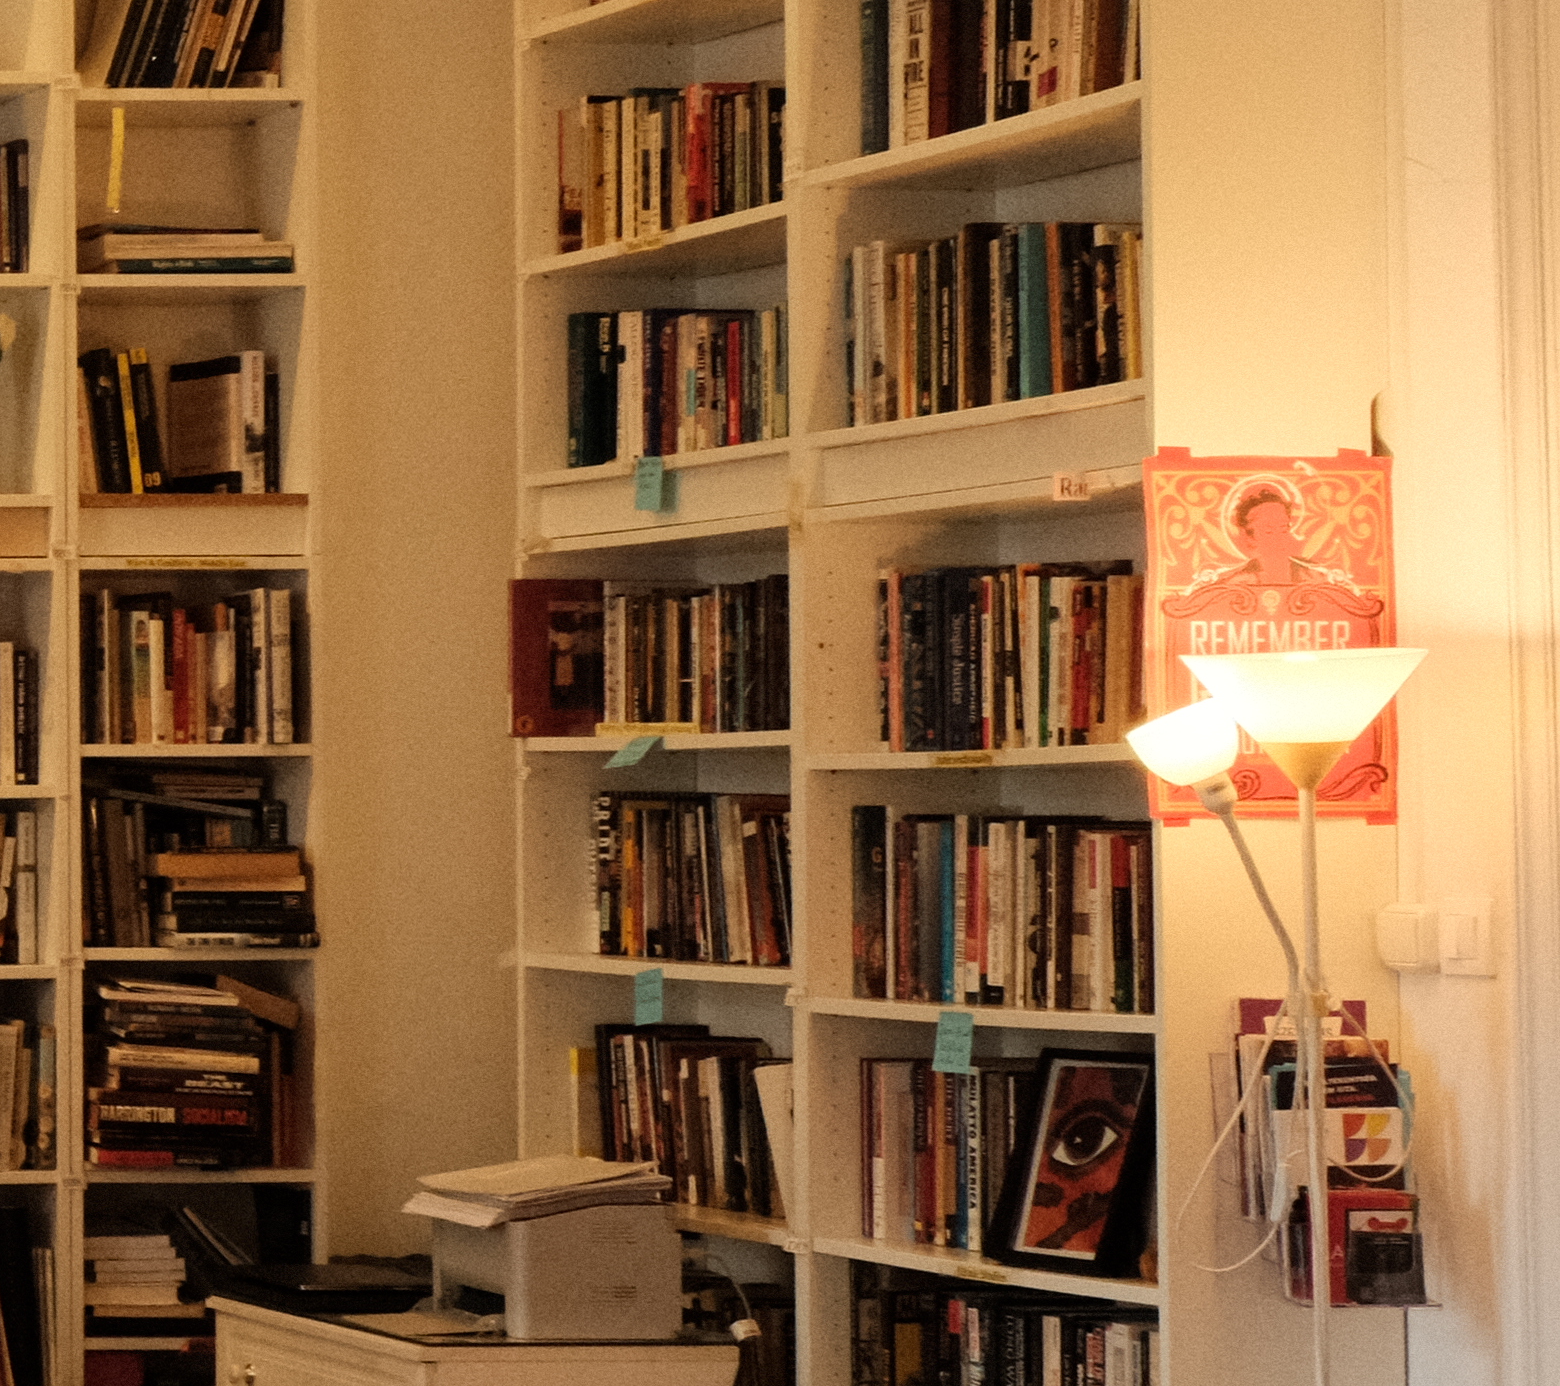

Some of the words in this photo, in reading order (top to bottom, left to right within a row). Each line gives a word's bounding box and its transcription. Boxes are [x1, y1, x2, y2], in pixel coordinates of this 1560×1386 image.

[951, 613, 965, 655] Simple
[1190, 620, 1351, 652] REMEMBER
[951, 659, 965, 705] Justice
[101, 1105, 175, 1124] HARRINGTON
[181, 1107, 247, 1126] SOCIALISM
[968, 1074, 978, 1138] MULATTO
[968, 1142, 978, 1209] AMERICA
[1004, 1314, 1015, 1359] LONG
